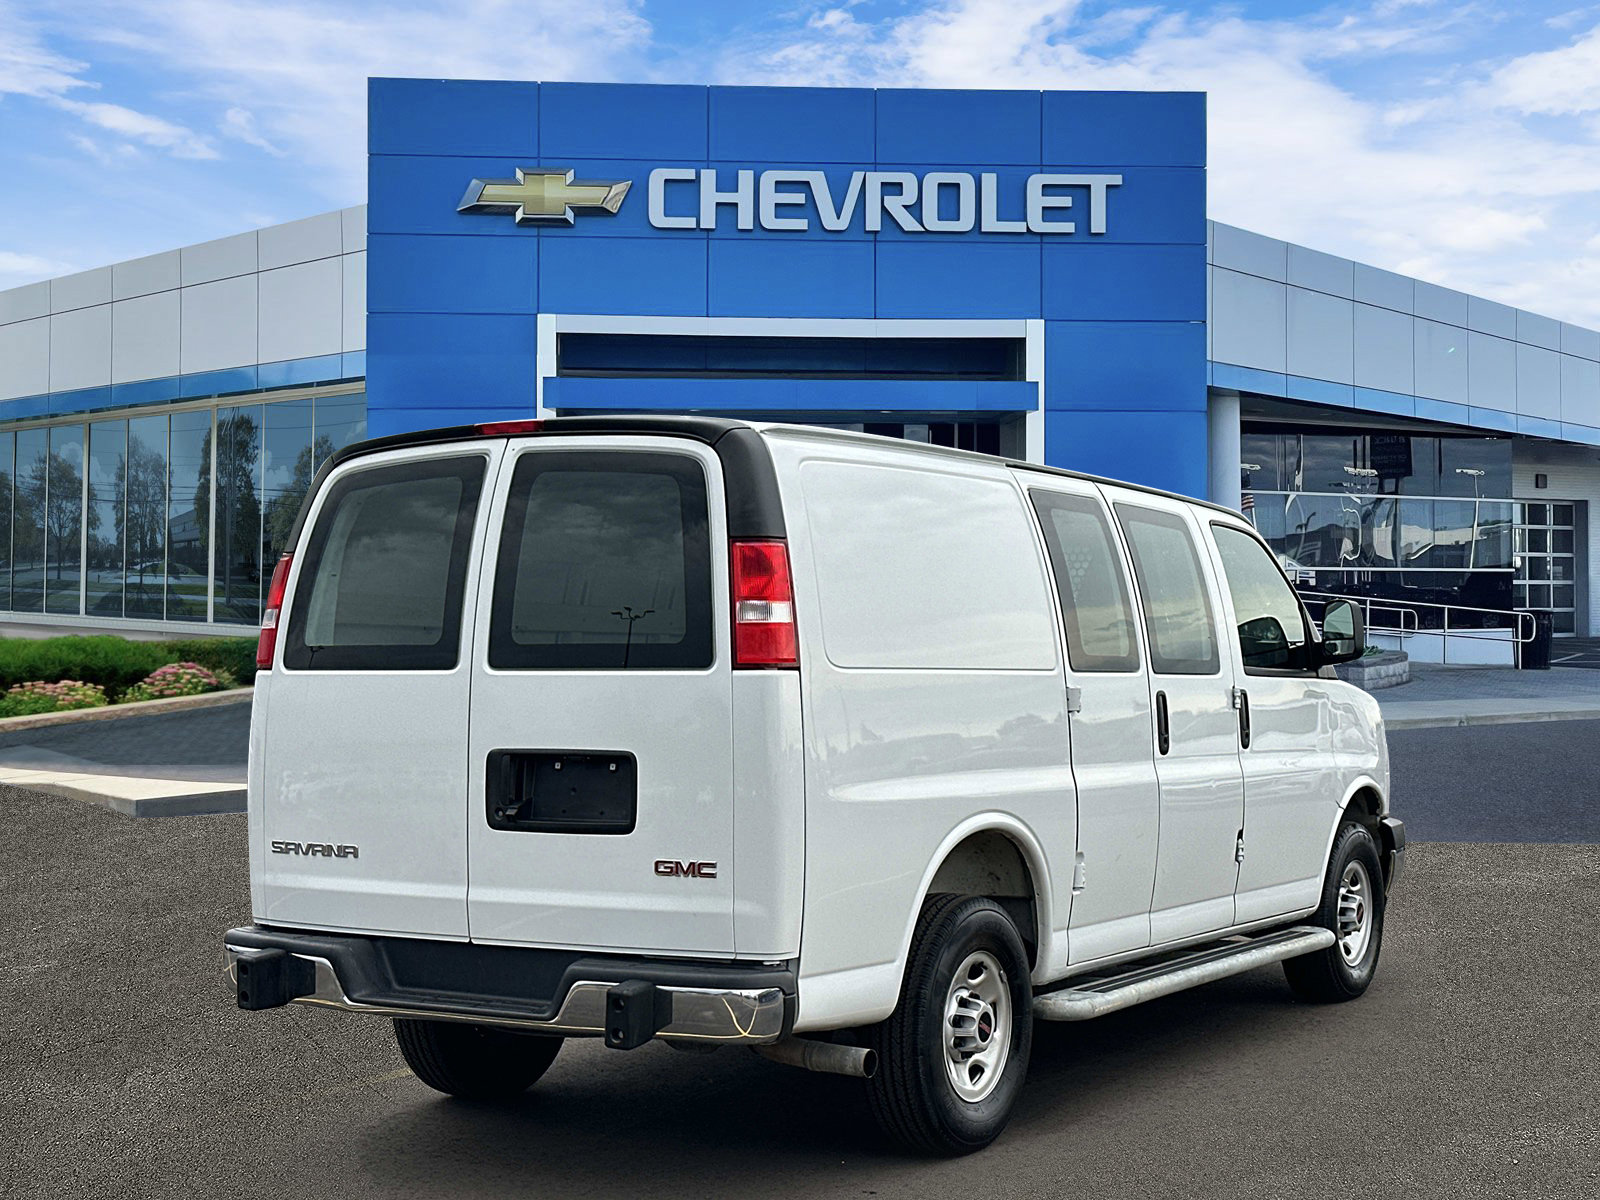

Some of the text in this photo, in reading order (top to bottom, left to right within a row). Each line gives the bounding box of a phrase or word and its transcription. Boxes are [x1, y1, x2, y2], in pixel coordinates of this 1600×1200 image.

[648, 167, 1123, 234] CHEVROLET
[271, 840, 360, 859] SAVANA
[654, 858, 717, 879] GMC
